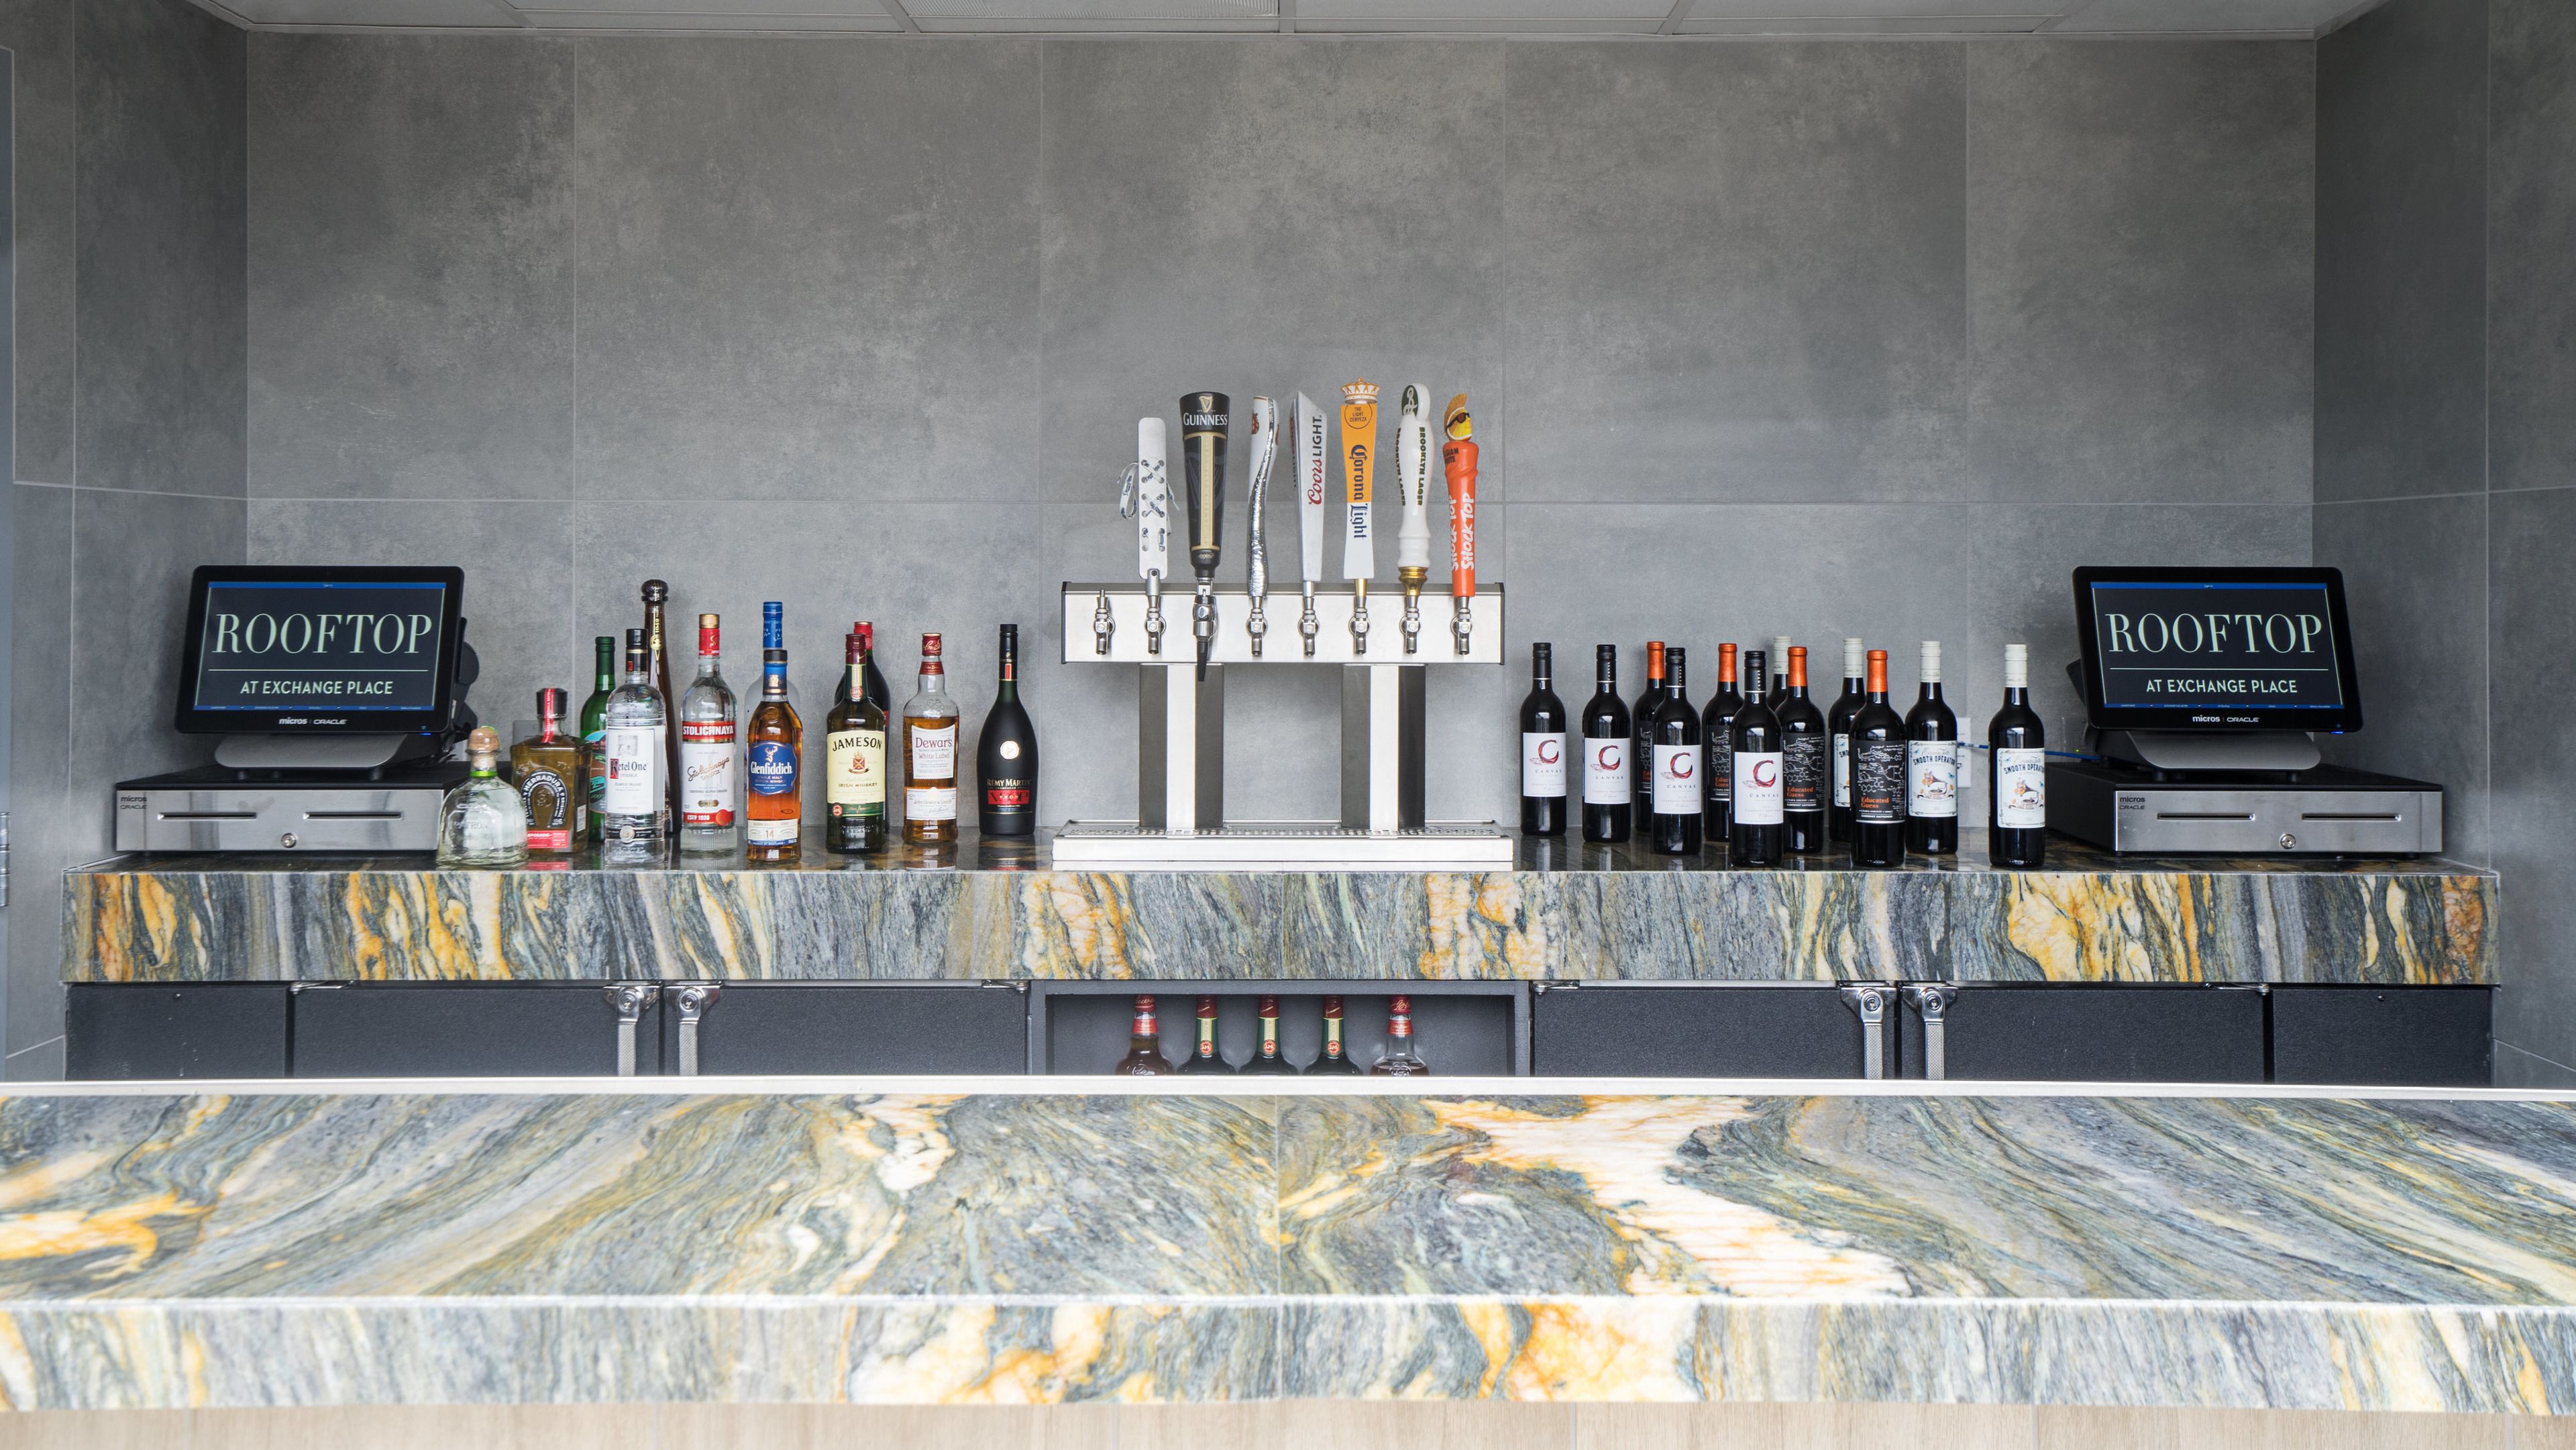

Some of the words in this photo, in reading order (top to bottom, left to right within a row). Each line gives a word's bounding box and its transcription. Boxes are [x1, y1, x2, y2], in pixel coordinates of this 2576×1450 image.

[1183, 412, 1228, 426] GUINNESS
[1312, 417, 1322, 456] LIGHT
[1348, 444, 1368, 501] Corona
[1307, 458, 1322, 505] Coors
[1398, 478, 1406, 507] LAGER
[1417, 477, 1425, 506] LAGER
[1460, 492, 1474, 521] TOP
[1350, 503, 1368, 539] Light
[1460, 523, 1474, 571] SHOCK
[211, 613, 433, 654] ROOFTOP
[2104, 613, 2322, 654] ROOFTOP
[240, 681, 259, 694] AT
[262, 681, 343, 694] EXCHANGE
[347, 682, 393, 694] PLACE
[2147, 680, 2162, 692] AT
[2167, 680, 2247, 692] EXCHANGE
[2251, 680, 2298, 693] PLACE
[279, 717, 307, 725] micros
[2192, 715, 2220, 723] micros
[683, 726, 734, 735] STOLICHNAYA
[833, 737, 882, 752] JAMESON
[916, 737, 952, 748] Dewar's
[611, 759, 630, 776] Ketel
[631, 761, 647, 771] One
[751, 761, 792, 774] Glenfiddich
[1913, 756, 1933, 766] SMOOTH
[1934, 756, 1955, 766] OPERATOR
[2004, 764, 2025, 774] SMOOTH
[2027, 764, 2045, 774] OPERATO
[523, 774, 564, 792] HERRADURA
[1006, 778, 1030, 786] MARTIN
[765, 829, 773, 838] 14
